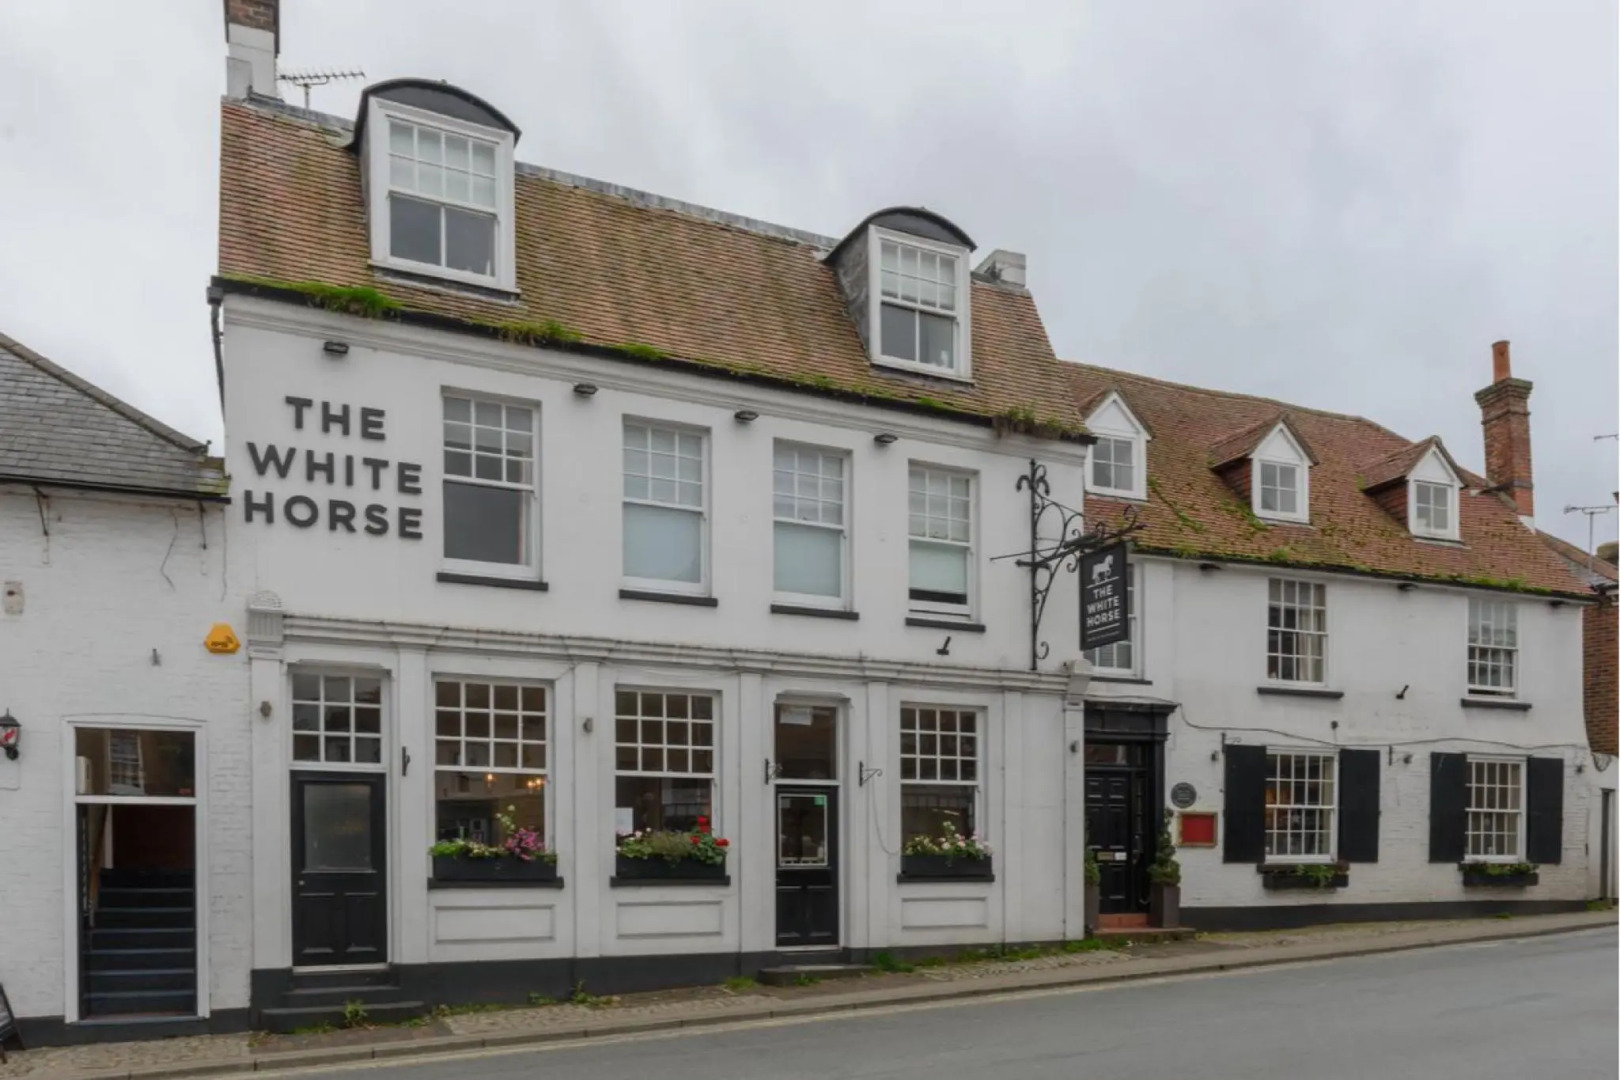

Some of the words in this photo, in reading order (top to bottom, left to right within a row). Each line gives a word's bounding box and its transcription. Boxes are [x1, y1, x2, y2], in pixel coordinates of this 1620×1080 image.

[285, 396, 386, 440] THE
[247, 442, 422, 494] WHITE
[244, 490, 423, 539] HORSE
[1087, 595, 1119, 614] WHITE
[1093, 584, 1113, 599] THE
[1086, 608, 1120, 627] HORSE
